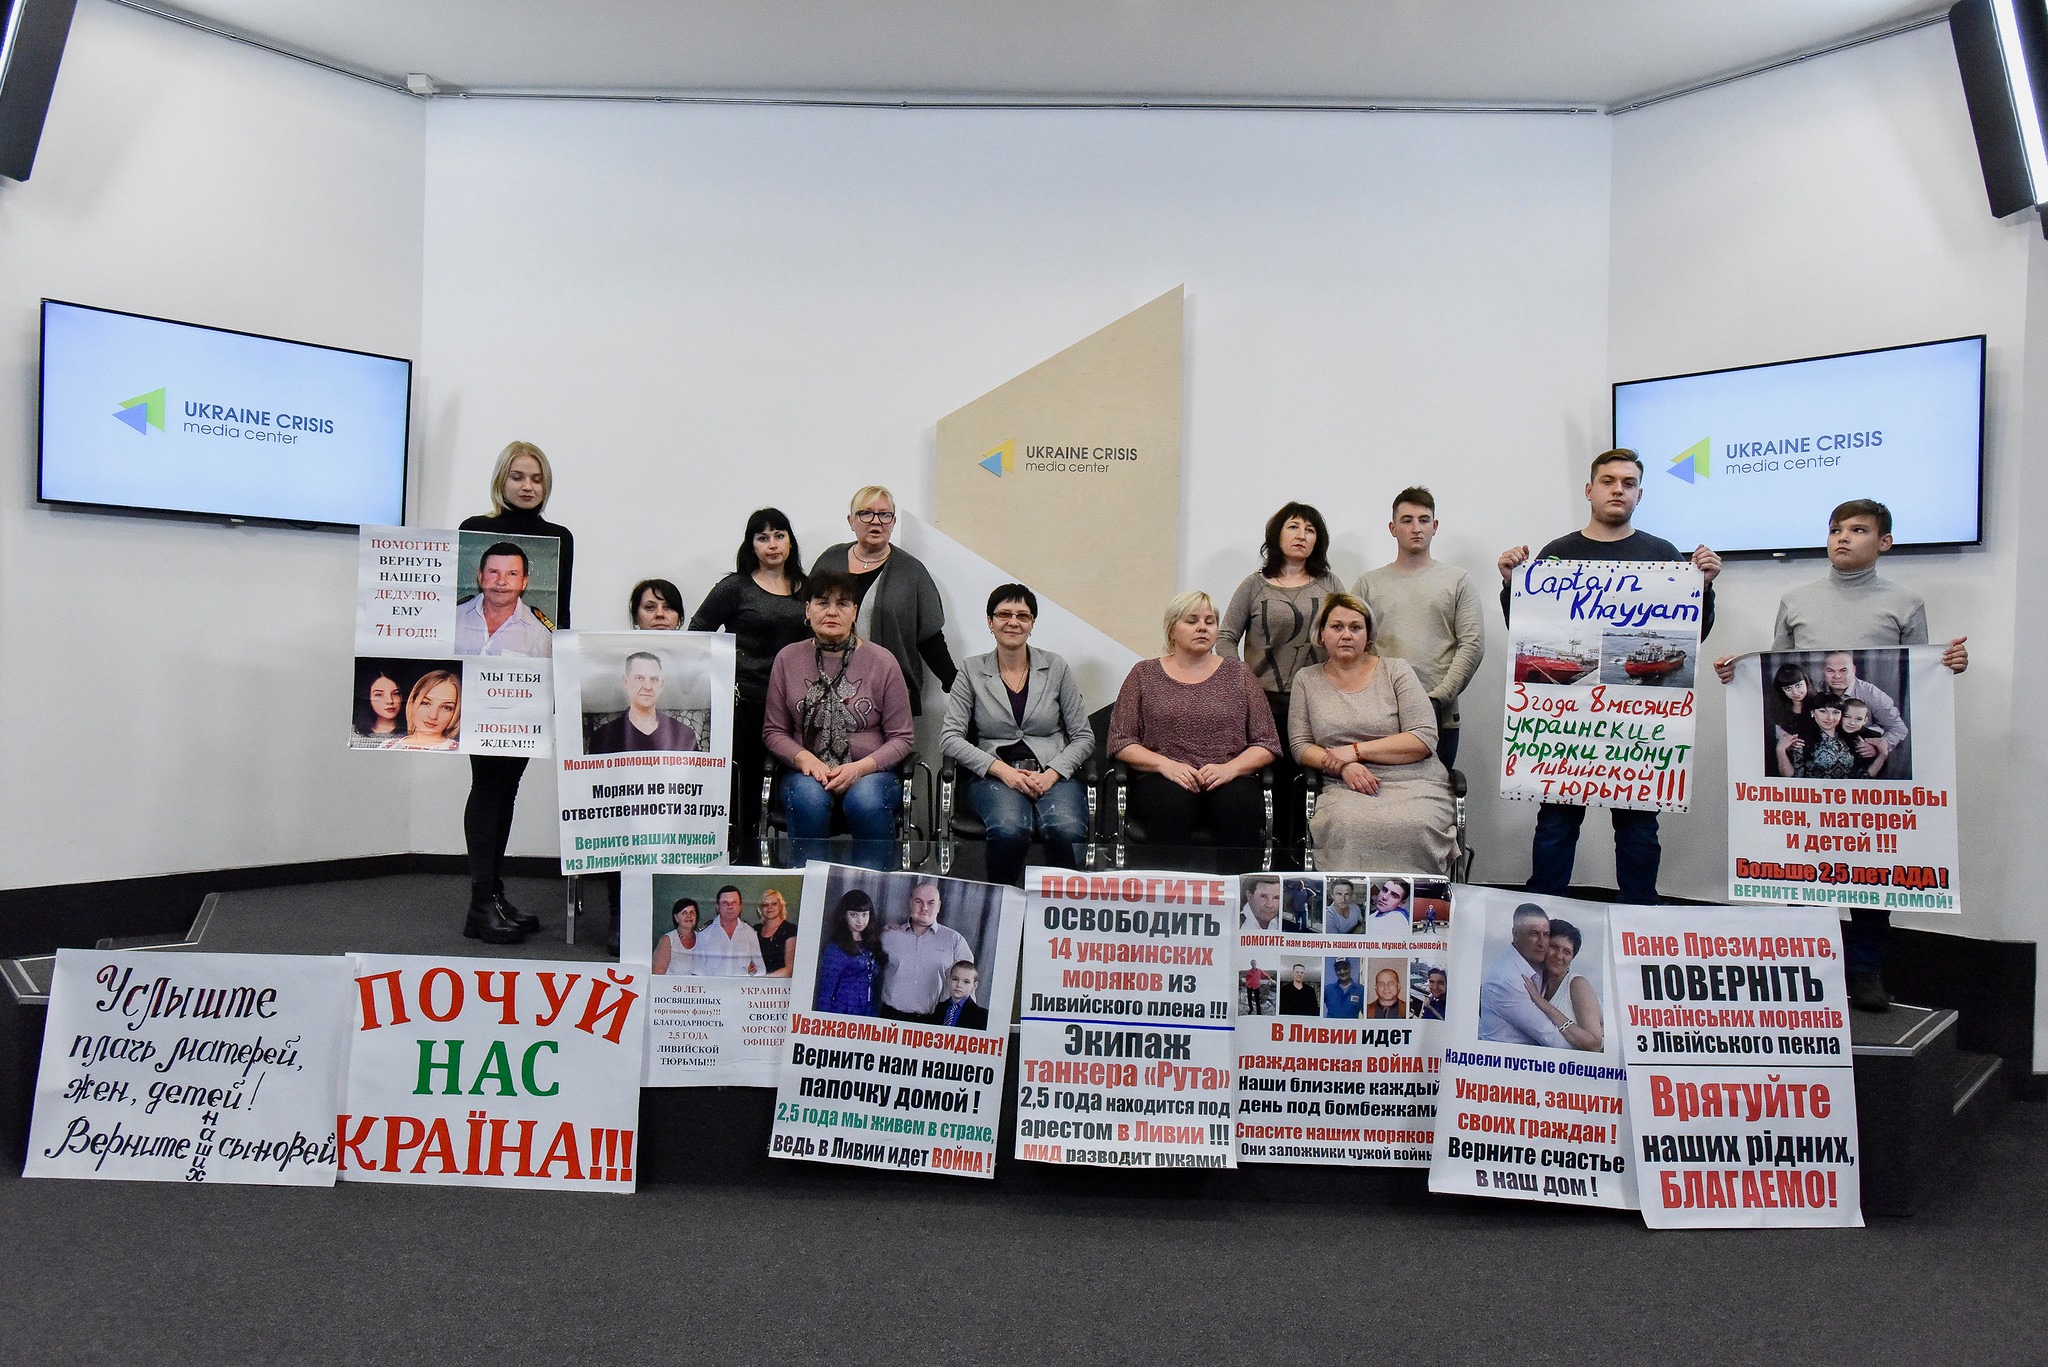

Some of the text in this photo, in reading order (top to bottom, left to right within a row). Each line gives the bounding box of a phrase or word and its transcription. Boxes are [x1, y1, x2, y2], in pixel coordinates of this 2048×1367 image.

[184, 400, 334, 434] UKRAINE CRISIS
[184, 422, 298, 445] media center
[1726, 431, 1883, 459] UKRAINE CRISIS
[1026, 446, 1137, 461] UKRAINE CRISIS
[1726, 454, 1841, 475] media center
[1026, 461, 1109, 473] media center
[371, 539, 450, 552] ПОМОГИТЕ
[380, 556, 442, 567] ВЕРНУТЬ
[380, 572, 441, 584] НАШЕГО
[375, 590, 440, 602] ДЕДУЛЮ,
[392, 606, 422, 617] ЕМУ
[376, 624, 437, 638] 71 ГОД!!!
[480, 672, 541, 683] МЫ ТЕБЯ
[487, 688, 533, 698] ОЧЕНЬ
[475, 724, 529, 734] ЛЮБИМ
[1504, 715, 1665, 742] украинские
[481, 739, 535, 749] ЖДЕМ!!!
[1507, 741, 1692, 770] моряки гибнут
[564, 755, 726, 771] Молим помощи президента!
[1530, 758, 1654, 781] ливийской
[592, 783, 703, 799] Моряки несут
[1736, 782, 1948, 806] Услышьте мольбы
[562, 803, 727, 821] ответственности груз.
[1763, 808, 1916, 830] жен, матерей
[575, 831, 716, 850] Верните наших мужей
[1804, 832, 1870, 853] детей
[586, 852, 658, 869] Ливийских
[1736, 858, 1936, 891] Больше 2,5 лет АДА
[1041, 876, 1225, 906] ПОМОГИТЕ
[1734, 884, 1953, 909] ВЕРНИТЕ МОРЯКОВ ДОМОЙ!
[1044, 906, 1220, 938] ОСВОБОДИТЬ
[1048, 937, 1213, 966] 14 украинских
[1241, 935, 1441, 951] ПОМОГИТЕ нам вернуть наших сыновей
[1622, 932, 1837, 961] Пане Президенте,
[1062, 969, 1196, 993] моряков из
[1640, 964, 1825, 1003] ПОВЕРНІТЬ
[355, 967, 640, 1045] ПОЧУЙ
[655, 997, 721, 1005] ПОСВЯЩЕННЫХ
[1030, 993, 1205, 1019] Ливийского плена
[654, 1019, 723, 1027] БЛАГОДАРНОСТЬ
[1628, 1005, 1843, 1030] Українських моряків
[669, 1032, 708, 1040] 2,5 ГОДА
[791, 1013, 1004, 1057] Уважаемый президент!
[1064, 1024, 1191, 1060] Экипаж
[1288, 1024, 1412, 1047] Ливии идет
[1652, 1031, 1841, 1055] Лівійського пекла
[155, 1032, 304, 1078] матерей,
[657, 1044, 719, 1053] ЛИВИЙСКОЙ
[1445, 1048, 1555, 1073] Надоели пустые
[413, 1039, 560, 1097] НАС
[661, 1058, 716, 1066] ТЮРЬМЫ!!!
[792, 1042, 994, 1085] Верните нам нашего
[1239, 1053, 1424, 1073] гражданская ВОЙНА
[1024, 1060, 1230, 1091] танкера «Рута»
[1239, 1076, 1286, 1092] Наши
[1290, 1078, 1365, 1094] близкие
[800, 1077, 968, 1113] папочку домой
[1021, 1086, 1230, 1119] 2,5 года находится под
[1455, 1078, 1623, 1114] Украина, защити
[1650, 1074, 1831, 1122] Врятуйте
[1239, 1099, 1282, 1114] день
[1287, 1101, 1320, 1116] под
[777, 1103, 994, 1144] 2,5 года живем страхе,
[1021, 1119, 1204, 1145] арестом Ливии
[1236, 1122, 1434, 1144] Спасите наших моряков
[1458, 1112, 1605, 1144] своих граждан
[43, 1116, 192, 1171] Верните
[337, 1110, 634, 1183] КРАЇНА!!!
[773, 1135, 982, 1173] ведь Ливии идет ВОЙНА
[1241, 1143, 1391, 1160] Они заложники чужой
[1448, 1137, 1625, 1173] Верните счастье
[1642, 1131, 1854, 1167] наших рідних,
[1066, 1148, 1152, 1165] разводит
[1493, 1171, 1587, 1196] наш дом
